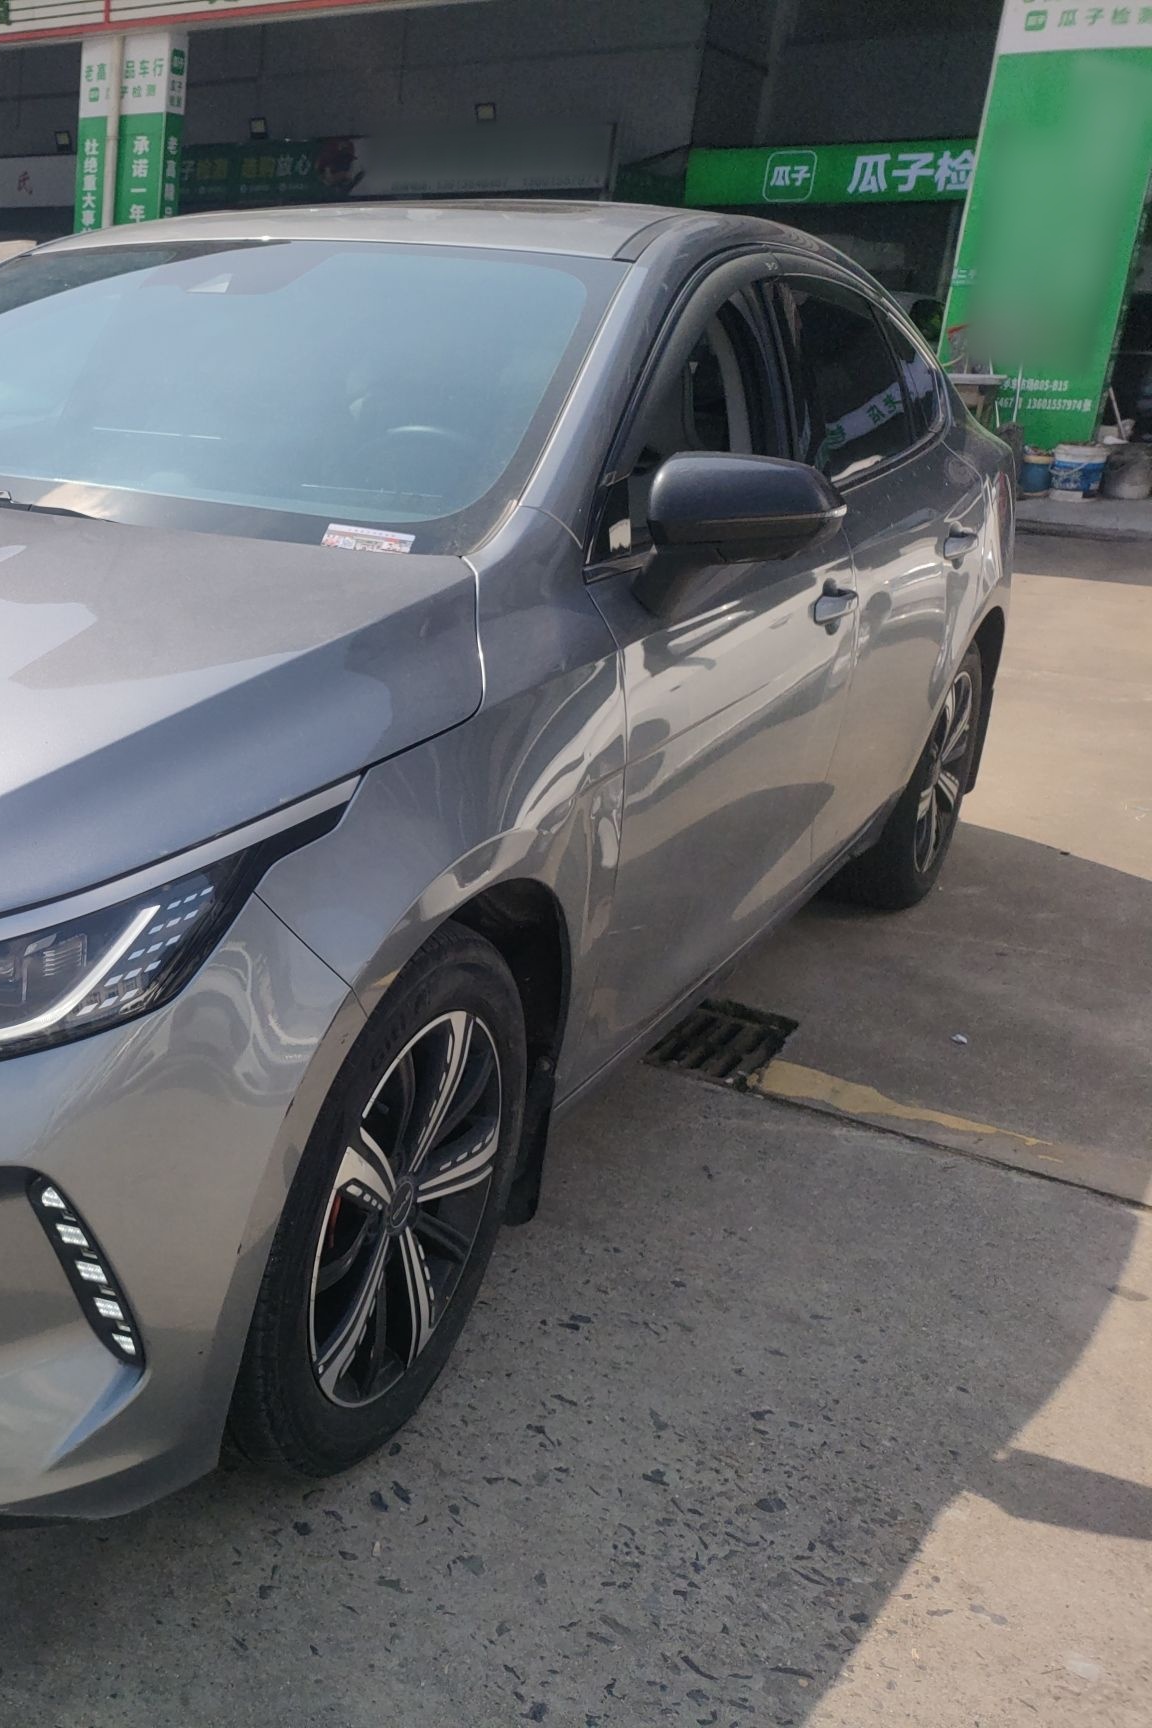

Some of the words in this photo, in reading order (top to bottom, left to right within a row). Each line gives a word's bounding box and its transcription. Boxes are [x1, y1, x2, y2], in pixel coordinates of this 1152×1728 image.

[129, 135, 150, 225] 承诺一年
[770, 164, 811, 188] 瓜子
[847, 149, 976, 195] 瓜子检
